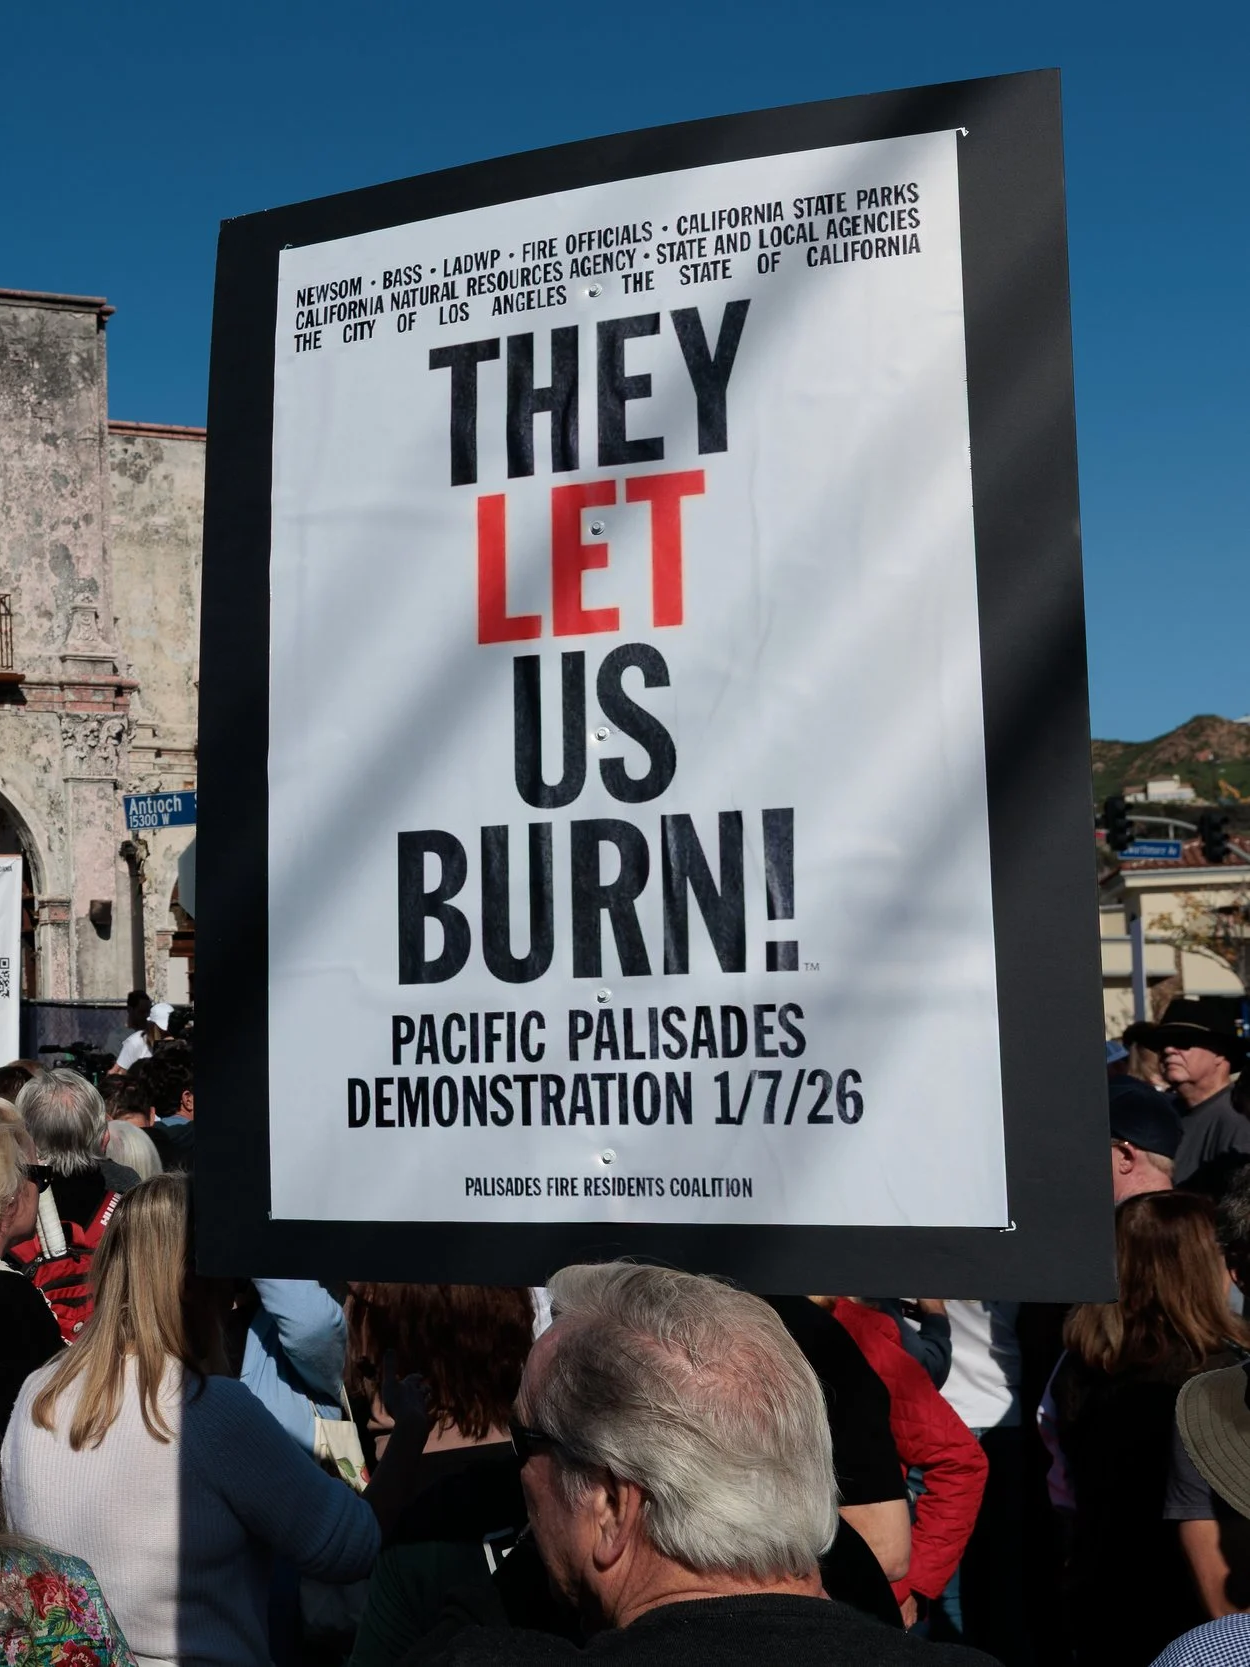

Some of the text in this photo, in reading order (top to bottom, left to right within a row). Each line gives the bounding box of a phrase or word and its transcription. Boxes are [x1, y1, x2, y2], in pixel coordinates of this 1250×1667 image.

[293, 232, 921, 353] THE CITY OF LOS ANGELES THE STATE OF CALIFORNIA
[295, 207, 921, 331] CALIFORNIA NATURAL RESOURCES AGENCY STATE AND LOCAL AGENCIES
[296, 182, 920, 309] NEWSOM BASS LADWP FIRE OFFICIALS CALIFORNIA STATE PARKS
[429, 298, 751, 487] THEY
[476, 469, 706, 645] LET
[512, 642, 677, 809] US
[129, 795, 182, 815] Antioch
[129, 813, 170, 828] 15300 W
[397, 807, 799, 986] BURN!
[803, 962, 821, 972] TM
[391, 1002, 807, 1066] PACIFIC PALISADES
[347, 1068, 864, 1129] DEMONSTRATION 1/7/26
[465, 1175, 753, 1199] PALISADES FIRE RESIDENTS COALITION
